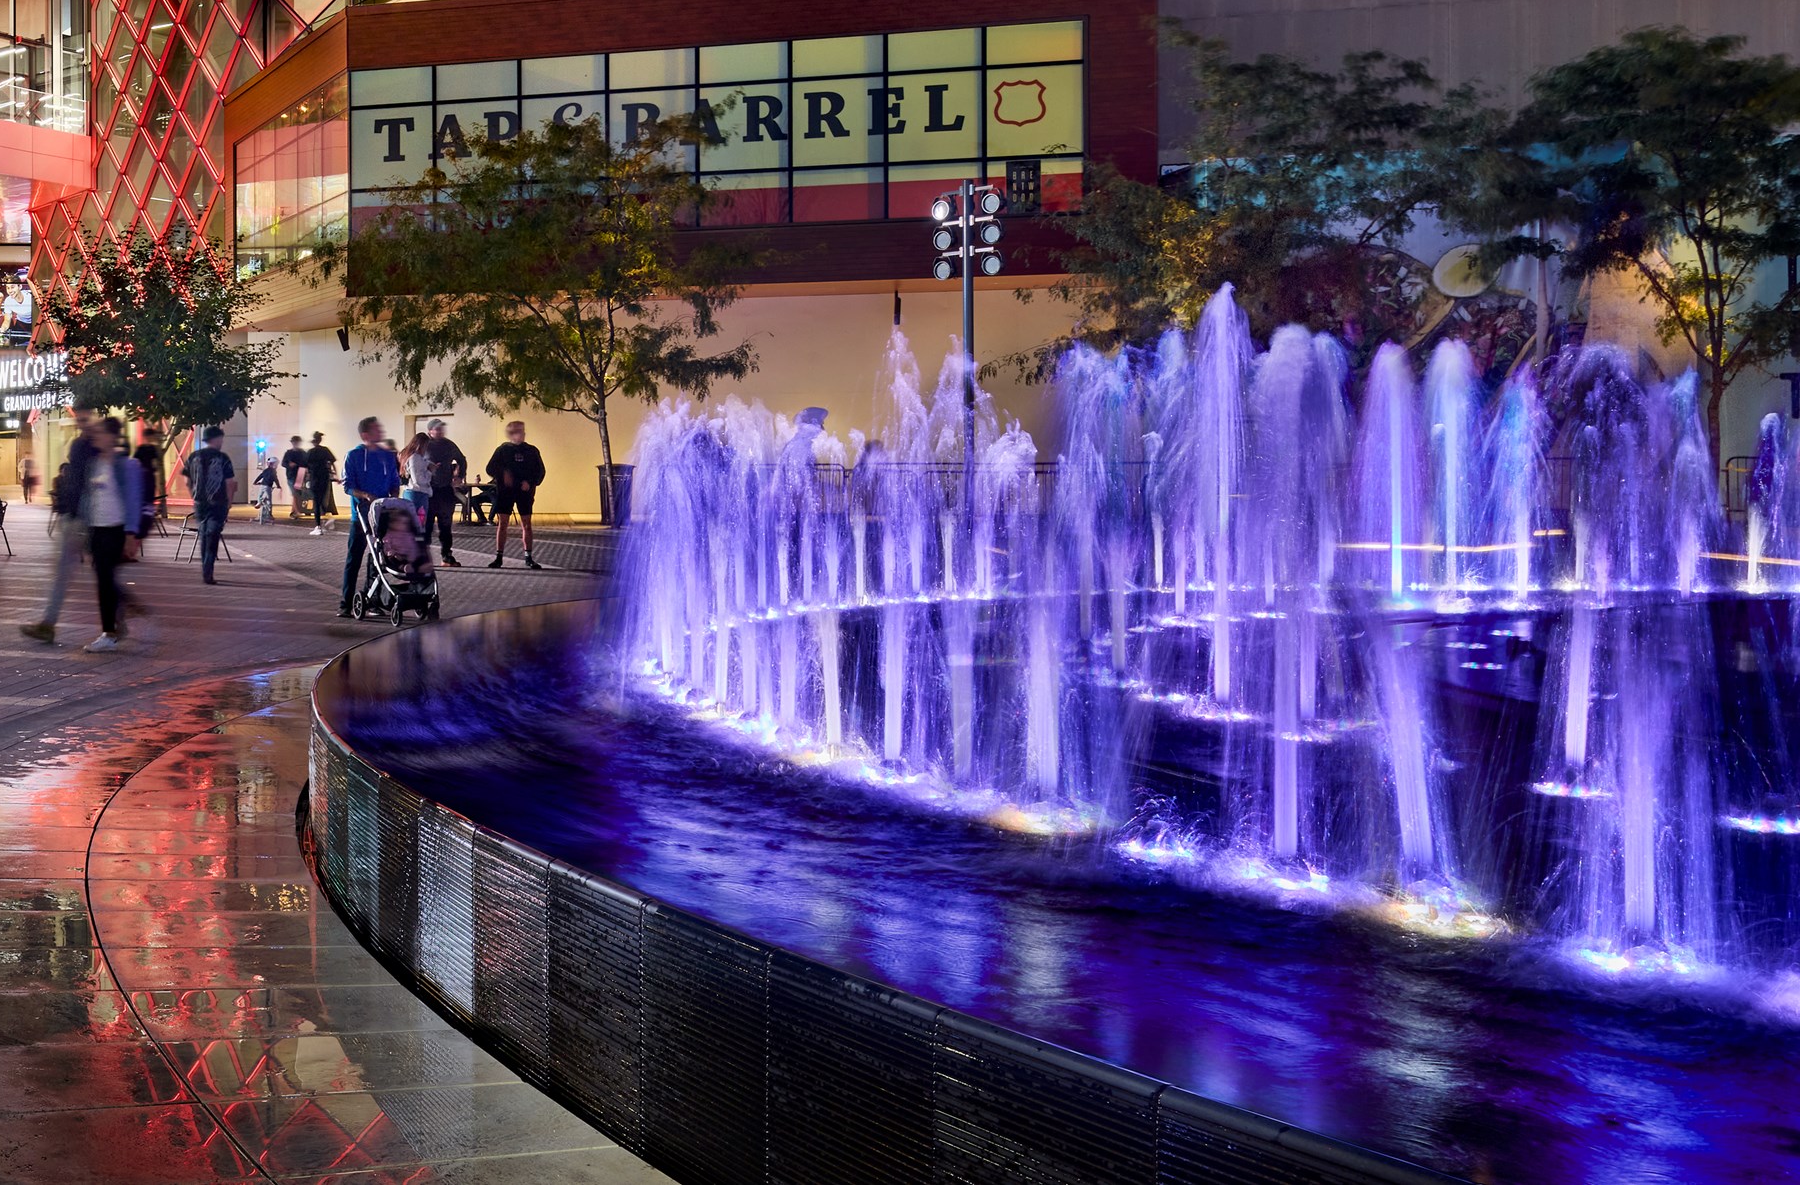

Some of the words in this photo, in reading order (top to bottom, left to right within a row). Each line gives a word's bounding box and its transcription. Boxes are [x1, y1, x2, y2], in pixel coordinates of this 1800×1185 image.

[374, 110, 521, 163] TAP
[621, 84, 966, 148] BARREL
[3, 394, 31, 412] GRAND
[31, 391, 57, 410] LOBBY
